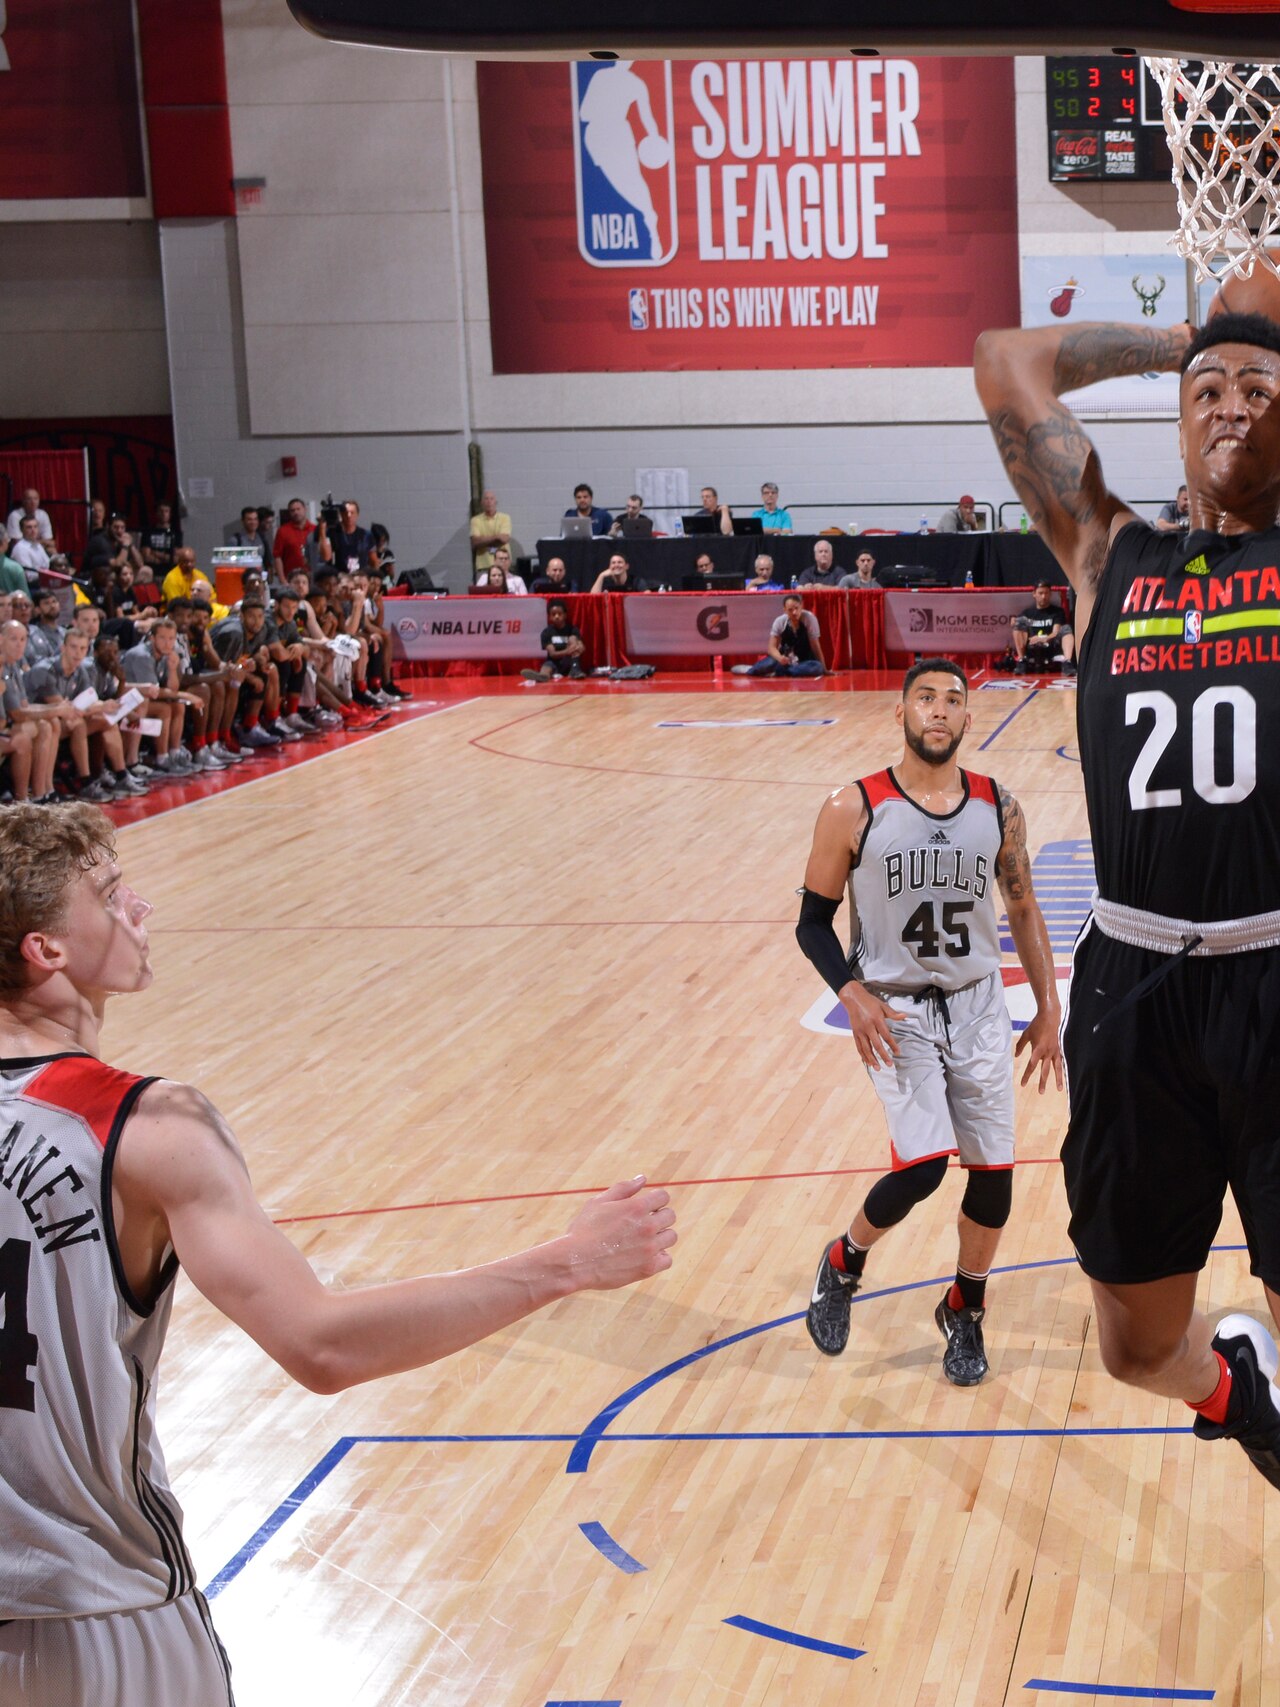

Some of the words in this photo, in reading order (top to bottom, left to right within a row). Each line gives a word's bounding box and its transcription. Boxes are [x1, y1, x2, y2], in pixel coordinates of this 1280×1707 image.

[1052, 70, 1080, 88] 45
[1088, 67, 1101, 88] 3
[1121, 68, 1135, 87] 4
[690, 60, 922, 159] SUMMER
[1053, 98, 1080, 117] 50
[1087, 97, 1101, 117] 2
[1121, 97, 1135, 116] 4
[1104, 131, 1135, 142] REAL
[1063, 155, 1090, 165] zero
[1105, 152, 1136, 162] TASTE
[696, 162, 890, 261] LEAGUE
[591, 213, 639, 250] NBA
[651, 287, 703, 329] THIS
[708, 287, 731, 328] IS
[733, 287, 784, 328] WHY
[786, 286, 822, 327] WE
[825, 285, 879, 327] PLAY
[431, 621, 464, 635] NBA
[468, 620, 502, 634] LIVE
[505, 620, 522, 634] 18
[936, 615, 967, 628] MGM
[1125, 685, 1257, 811] 20
[883, 847, 989, 902] BULLS
[901, 900, 974, 958] 45
